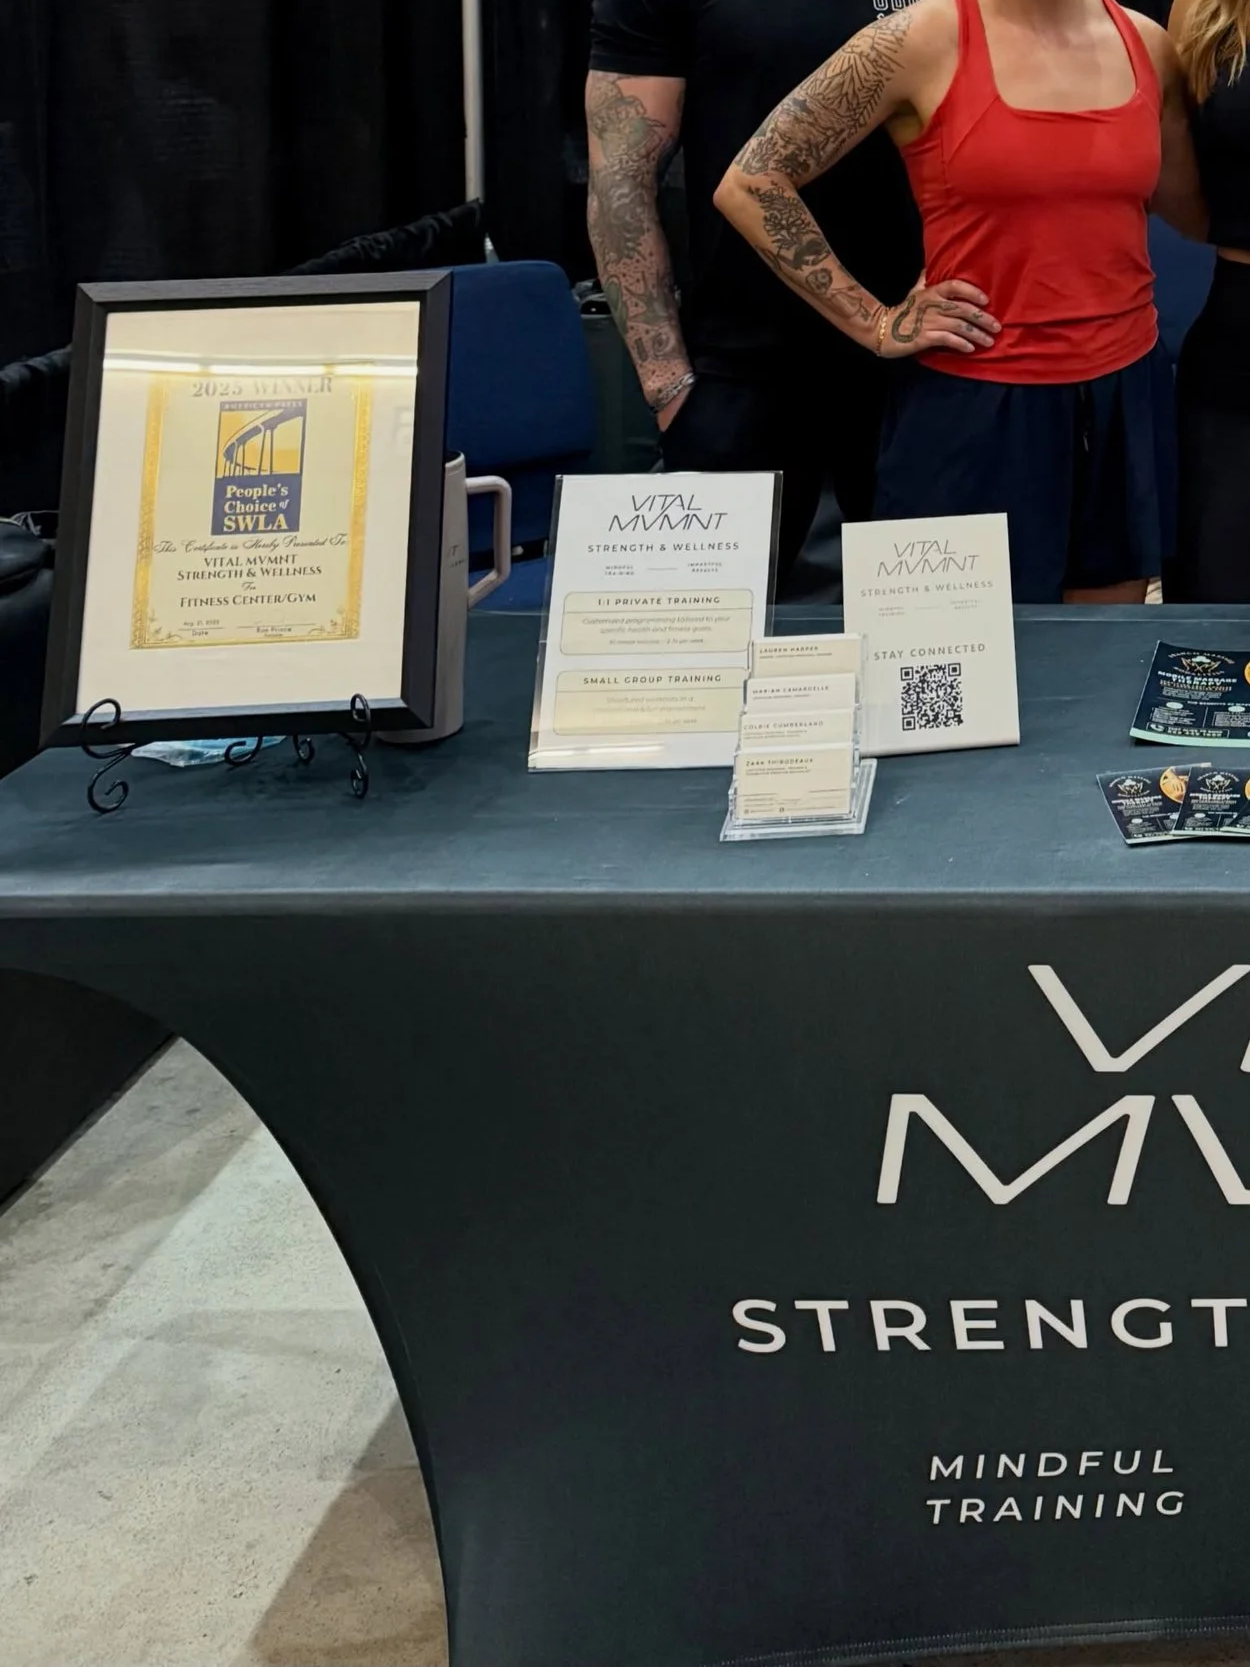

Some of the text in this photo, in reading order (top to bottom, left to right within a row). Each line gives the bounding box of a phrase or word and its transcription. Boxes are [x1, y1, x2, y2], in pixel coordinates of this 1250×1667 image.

[192, 377, 333, 397] 2025 WINNER
[225, 483, 289, 499] People's
[223, 499, 289, 514] Choice of
[632, 493, 702, 512] VITAL
[223, 513, 289, 532] SWLA
[608, 513, 728, 531] MVMNT
[588, 542, 739, 552] STRENGTH & WELLNESS
[894, 539, 957, 558] VITAL
[204, 554, 298, 567] VITAL MVMNT
[877, 555, 980, 577] MVMNT
[177, 566, 322, 581] STRENGTH & WELLNESS
[860, 585, 919, 597] STRENGTH
[936, 580, 993, 592] WELLNESS
[180, 593, 317, 608] FITNESS CENTER/GYM
[615, 597, 662, 605] PRIVATE
[668, 596, 720, 605] TRAINING
[874, 643, 985, 661] STAY CONNECTED
[624, 676, 662, 684] GROUP
[668, 675, 721, 683] TRAINING
[928, 1447, 1176, 1482] MINDFUL
[925, 1489, 1186, 1523] TRAINING
